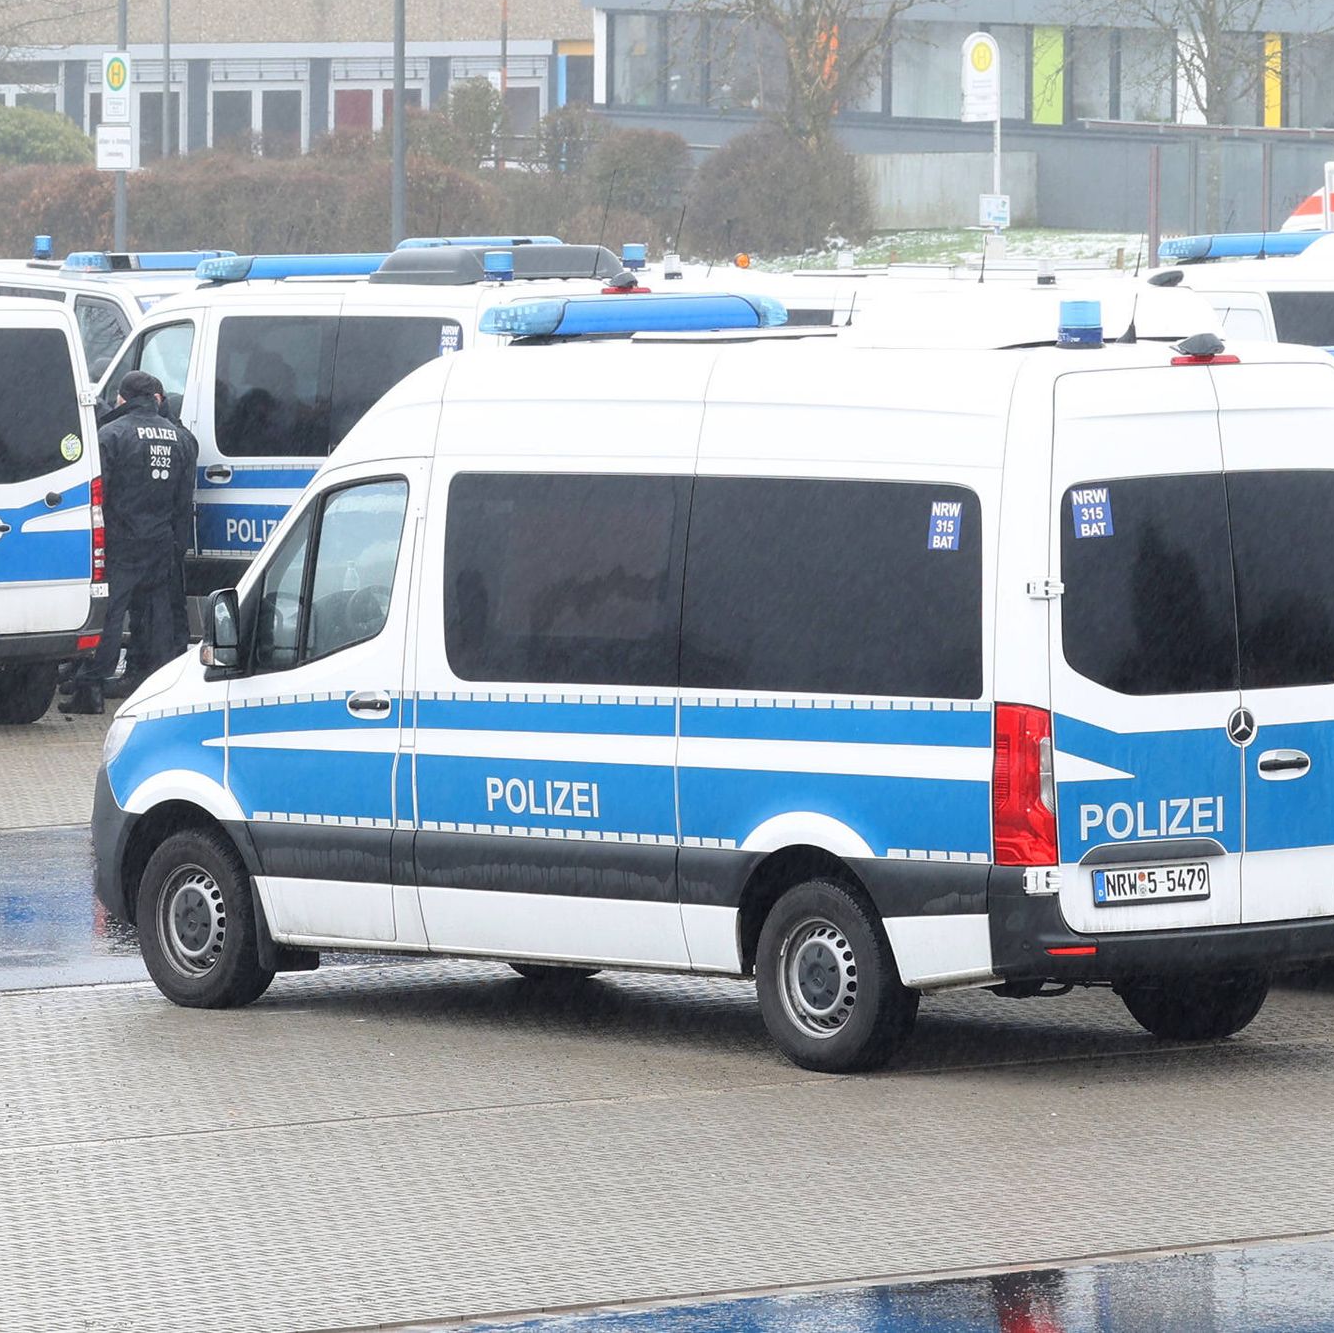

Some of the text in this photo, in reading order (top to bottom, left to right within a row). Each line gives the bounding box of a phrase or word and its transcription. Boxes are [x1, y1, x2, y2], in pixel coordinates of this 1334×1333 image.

[442, 325, 460, 335] NRW
[441, 336, 458, 346] 2632
[137, 427, 178, 442] POLIZEI
[150, 445, 171, 456] NRW
[150, 456, 171, 468] 2632
[1072, 489, 1107, 505] NRW
[932, 503, 962, 517] NRW
[1081, 507, 1104, 520] 315
[226, 518, 282, 543] POLIZ
[935, 520, 954, 533] 315
[1080, 523, 1107, 537] BAT
[932, 536, 954, 549] BAT
[486, 777, 599, 818] POLIZEI
[1080, 795, 1224, 841] POLIZEI
[1106, 873, 1137, 897] NRW
[1147, 868, 1206, 894] 5-5479
